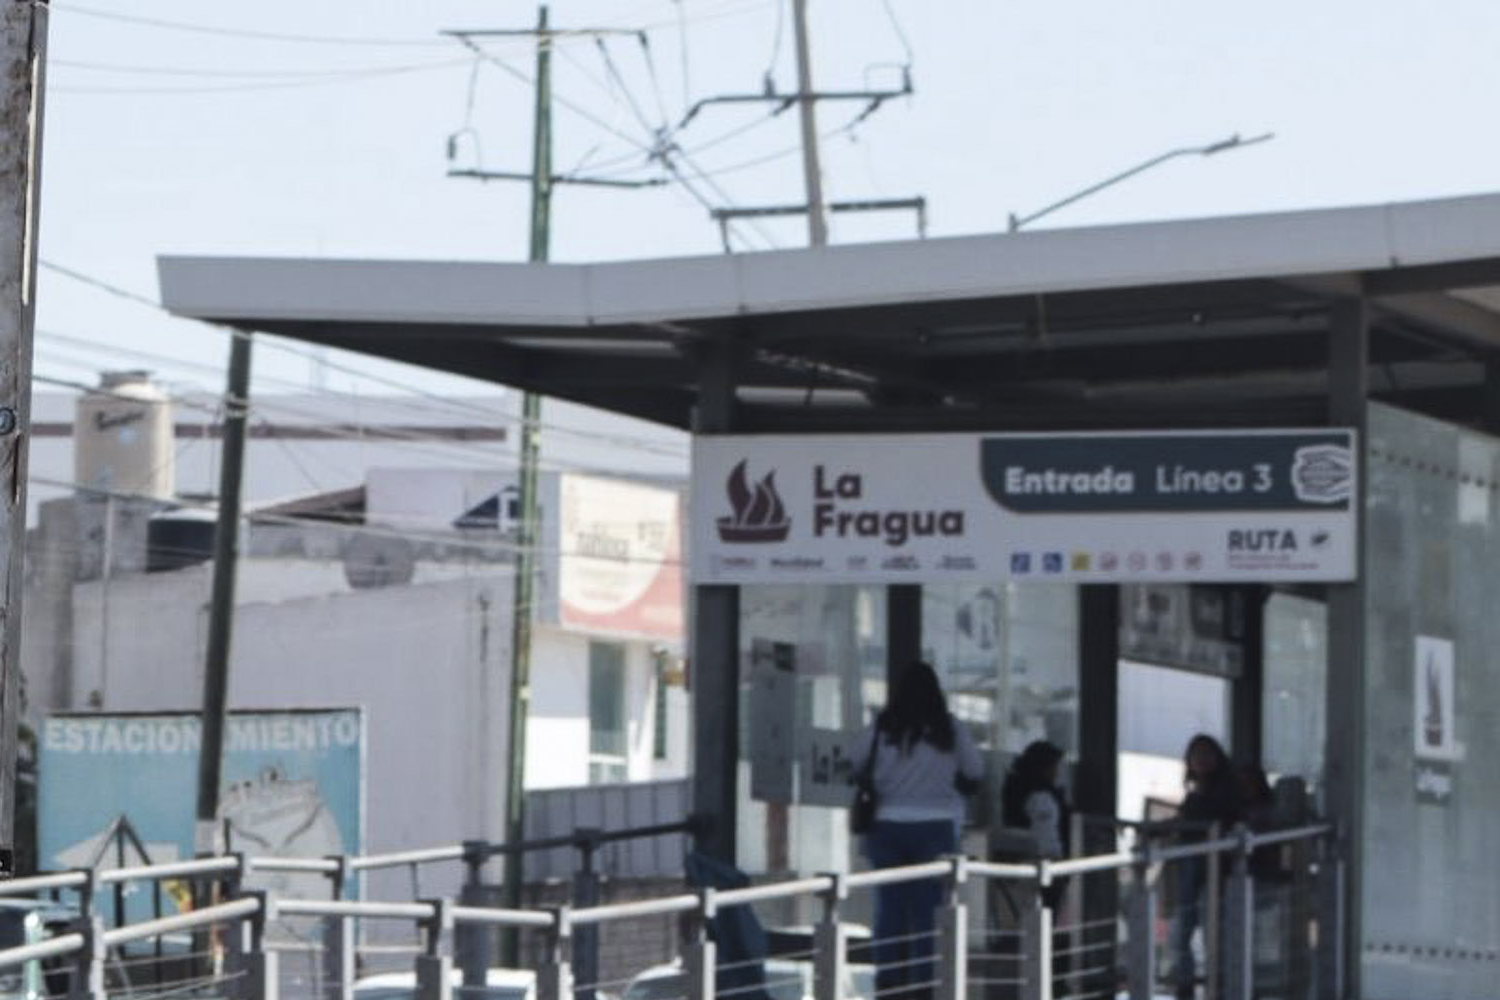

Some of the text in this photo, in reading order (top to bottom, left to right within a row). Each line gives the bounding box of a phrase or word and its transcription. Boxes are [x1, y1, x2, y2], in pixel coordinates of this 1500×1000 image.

[814, 464, 862, 499] La
[1004, 463, 1273, 495] Entrada Línea 3
[814, 503, 965, 547] Fragua
[1227, 528, 1299, 552] RUTA
[44, 715, 360, 753] ESTACIONMIENTO
